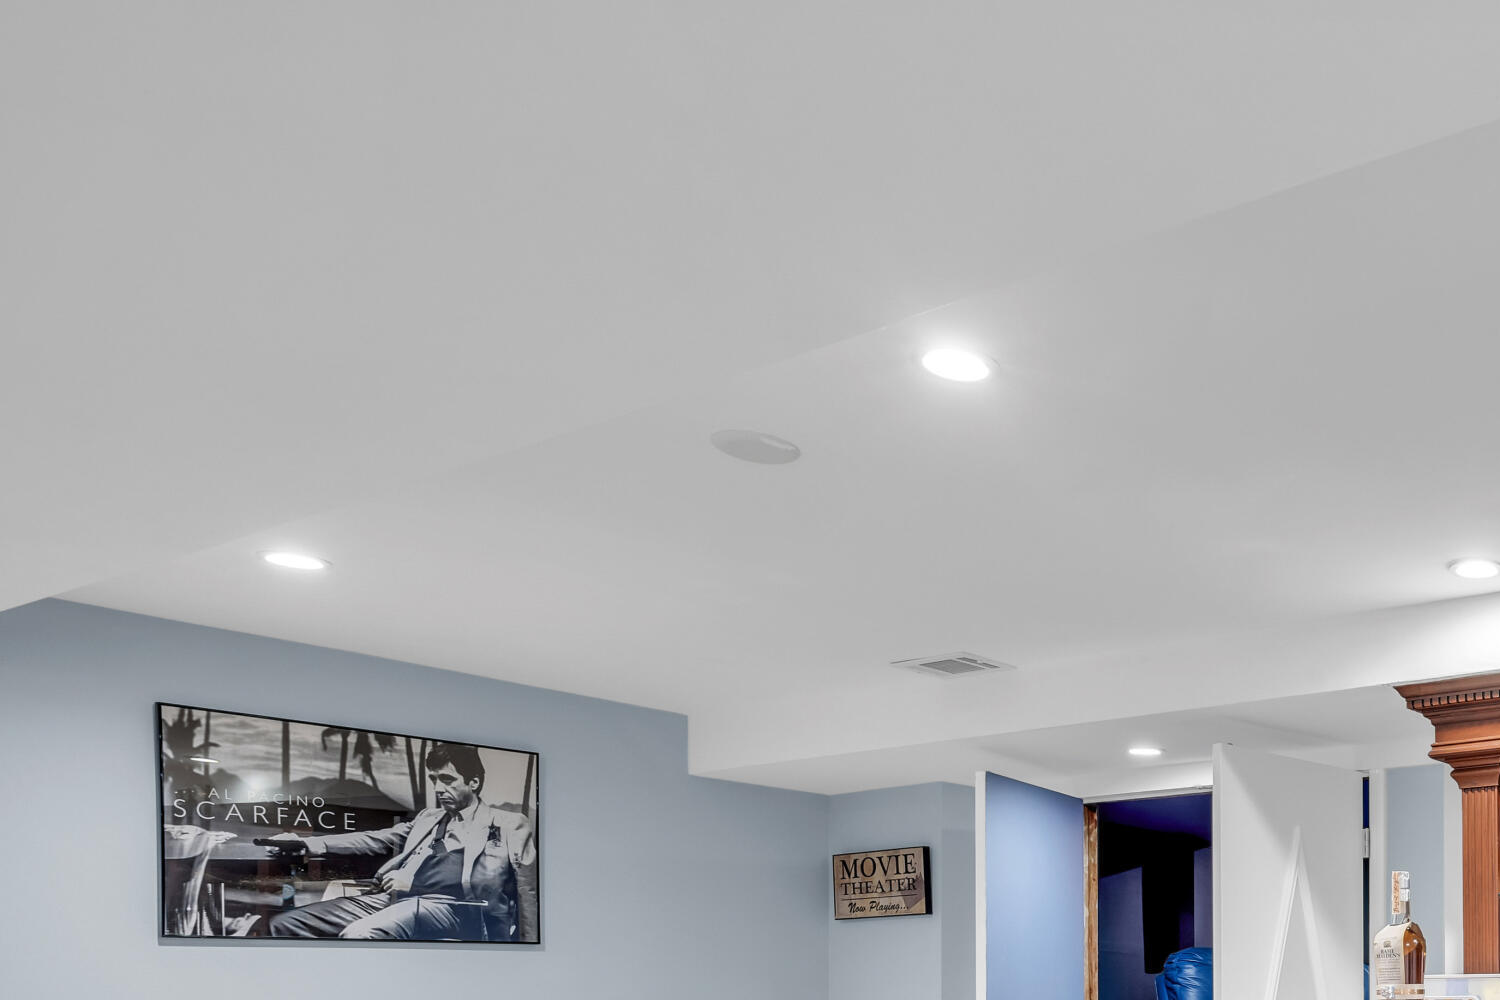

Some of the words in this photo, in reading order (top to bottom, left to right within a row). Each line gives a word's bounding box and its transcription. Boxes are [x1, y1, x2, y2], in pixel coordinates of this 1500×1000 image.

[208, 787, 232, 801] AL
[247, 789, 325, 808] PACINO
[173, 798, 357, 831] SCARFACE
[840, 853, 917, 880] MOVIE
[840, 877, 917, 896] THEATER
[848, 902, 866, 914] Now
